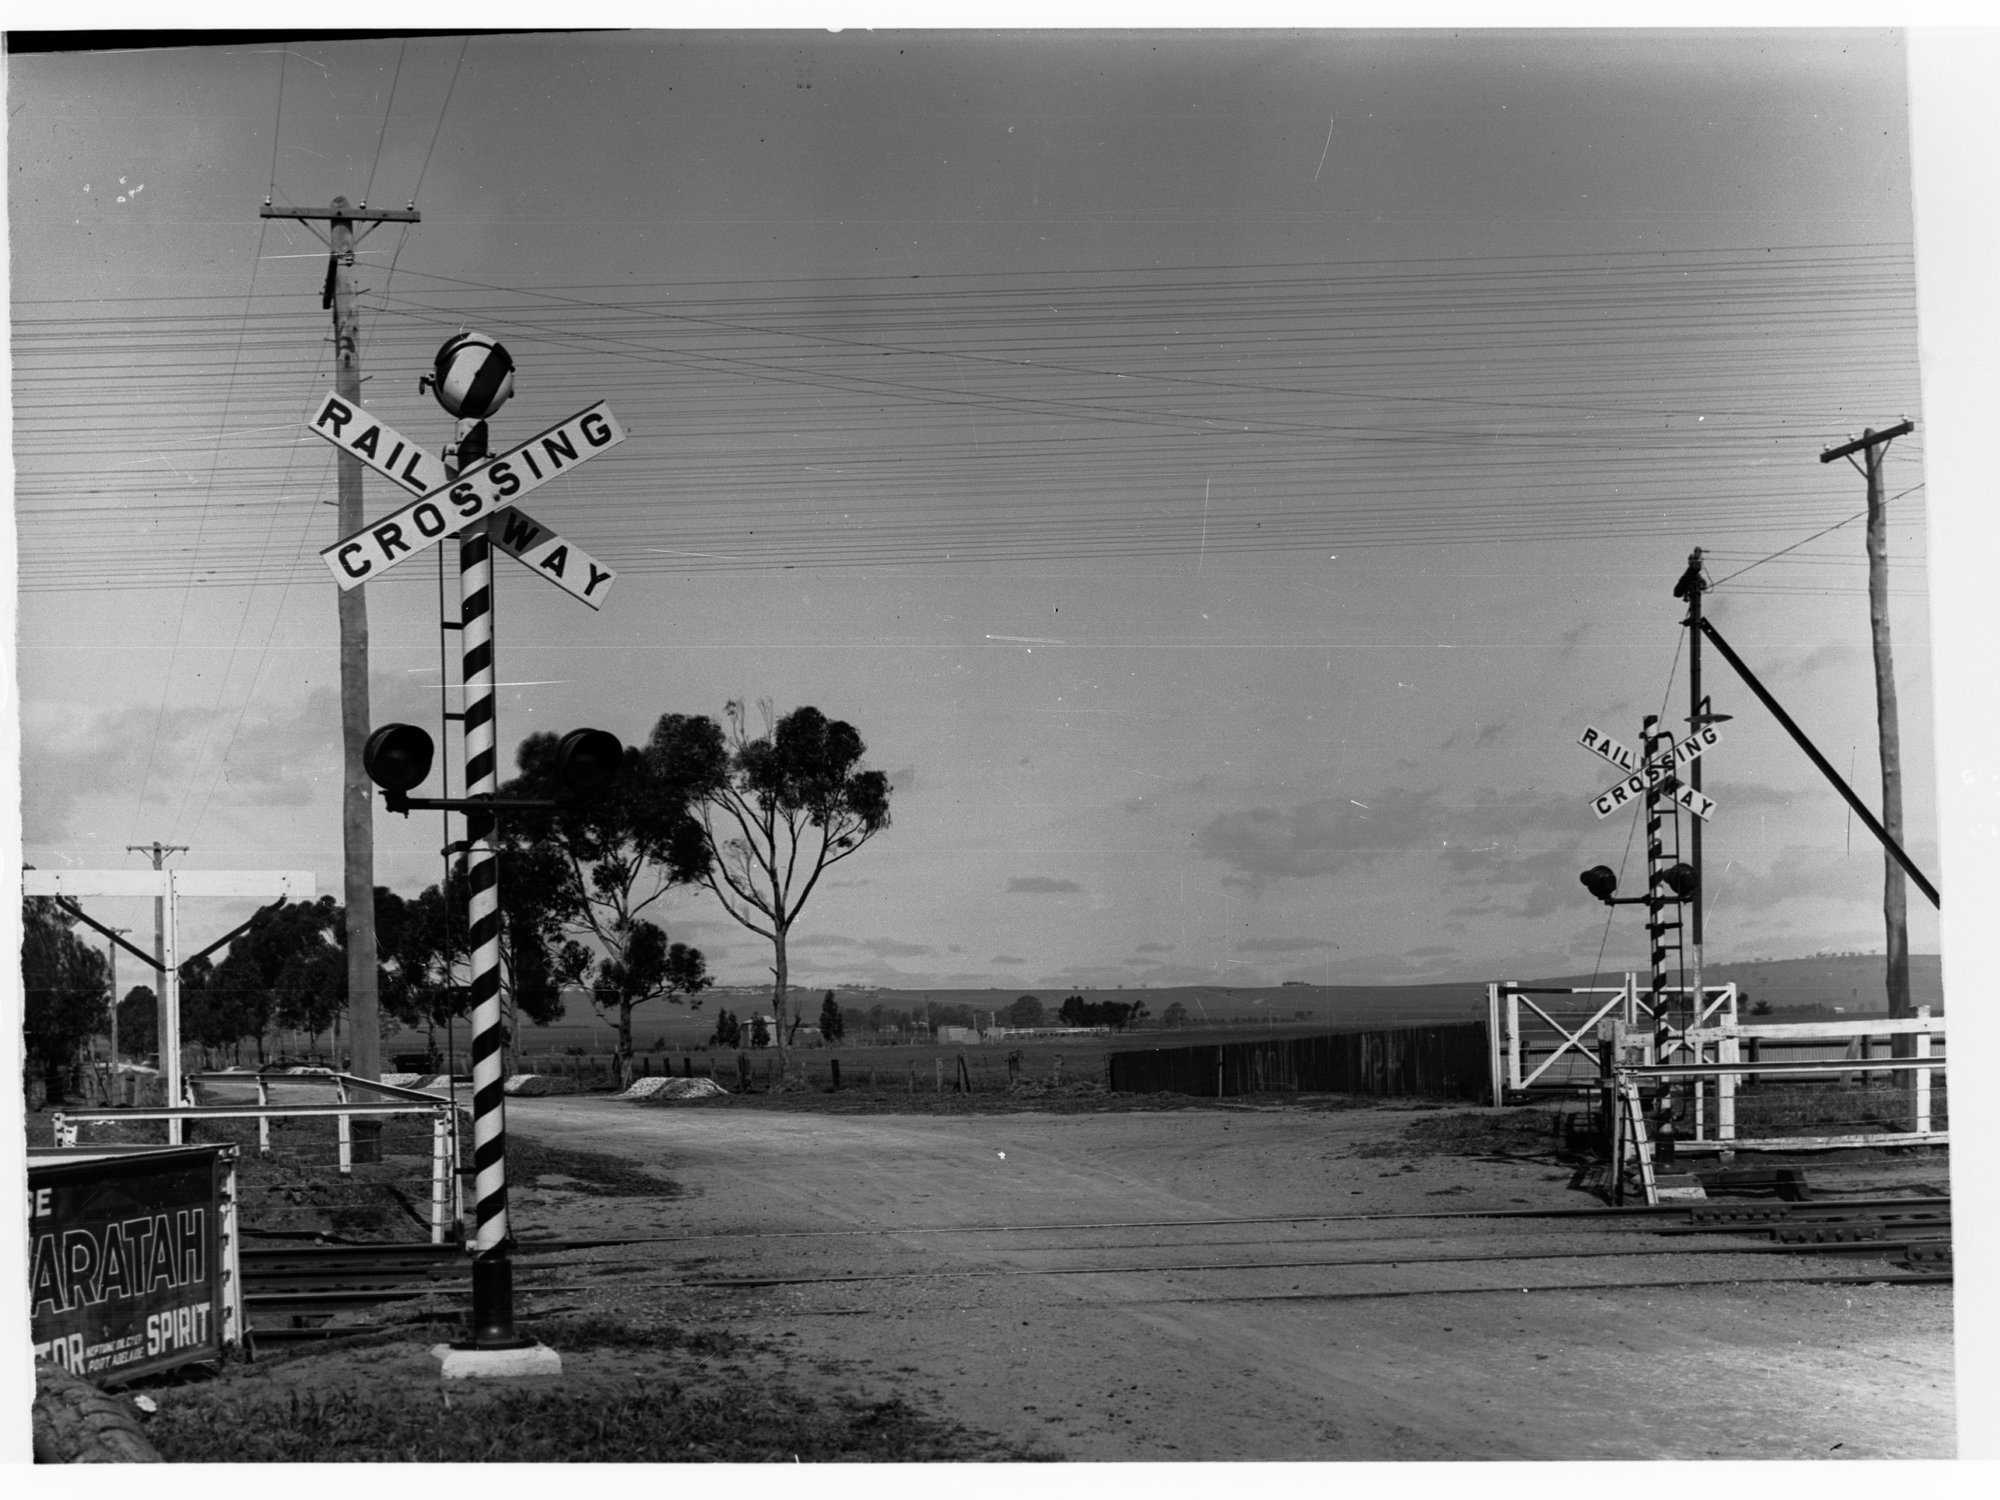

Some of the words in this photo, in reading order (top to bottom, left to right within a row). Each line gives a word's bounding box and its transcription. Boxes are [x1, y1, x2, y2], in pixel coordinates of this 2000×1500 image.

[316, 397, 428, 492] RAIL
[502, 511, 611, 597] WAY
[337, 412, 612, 578] CROSSING
[1582, 727, 1632, 770] RAIL
[1596, 727, 1717, 814] CROSSING
[29, 1208, 204, 1318] ARATAH
[147, 1302, 211, 1356] SPIRIT
